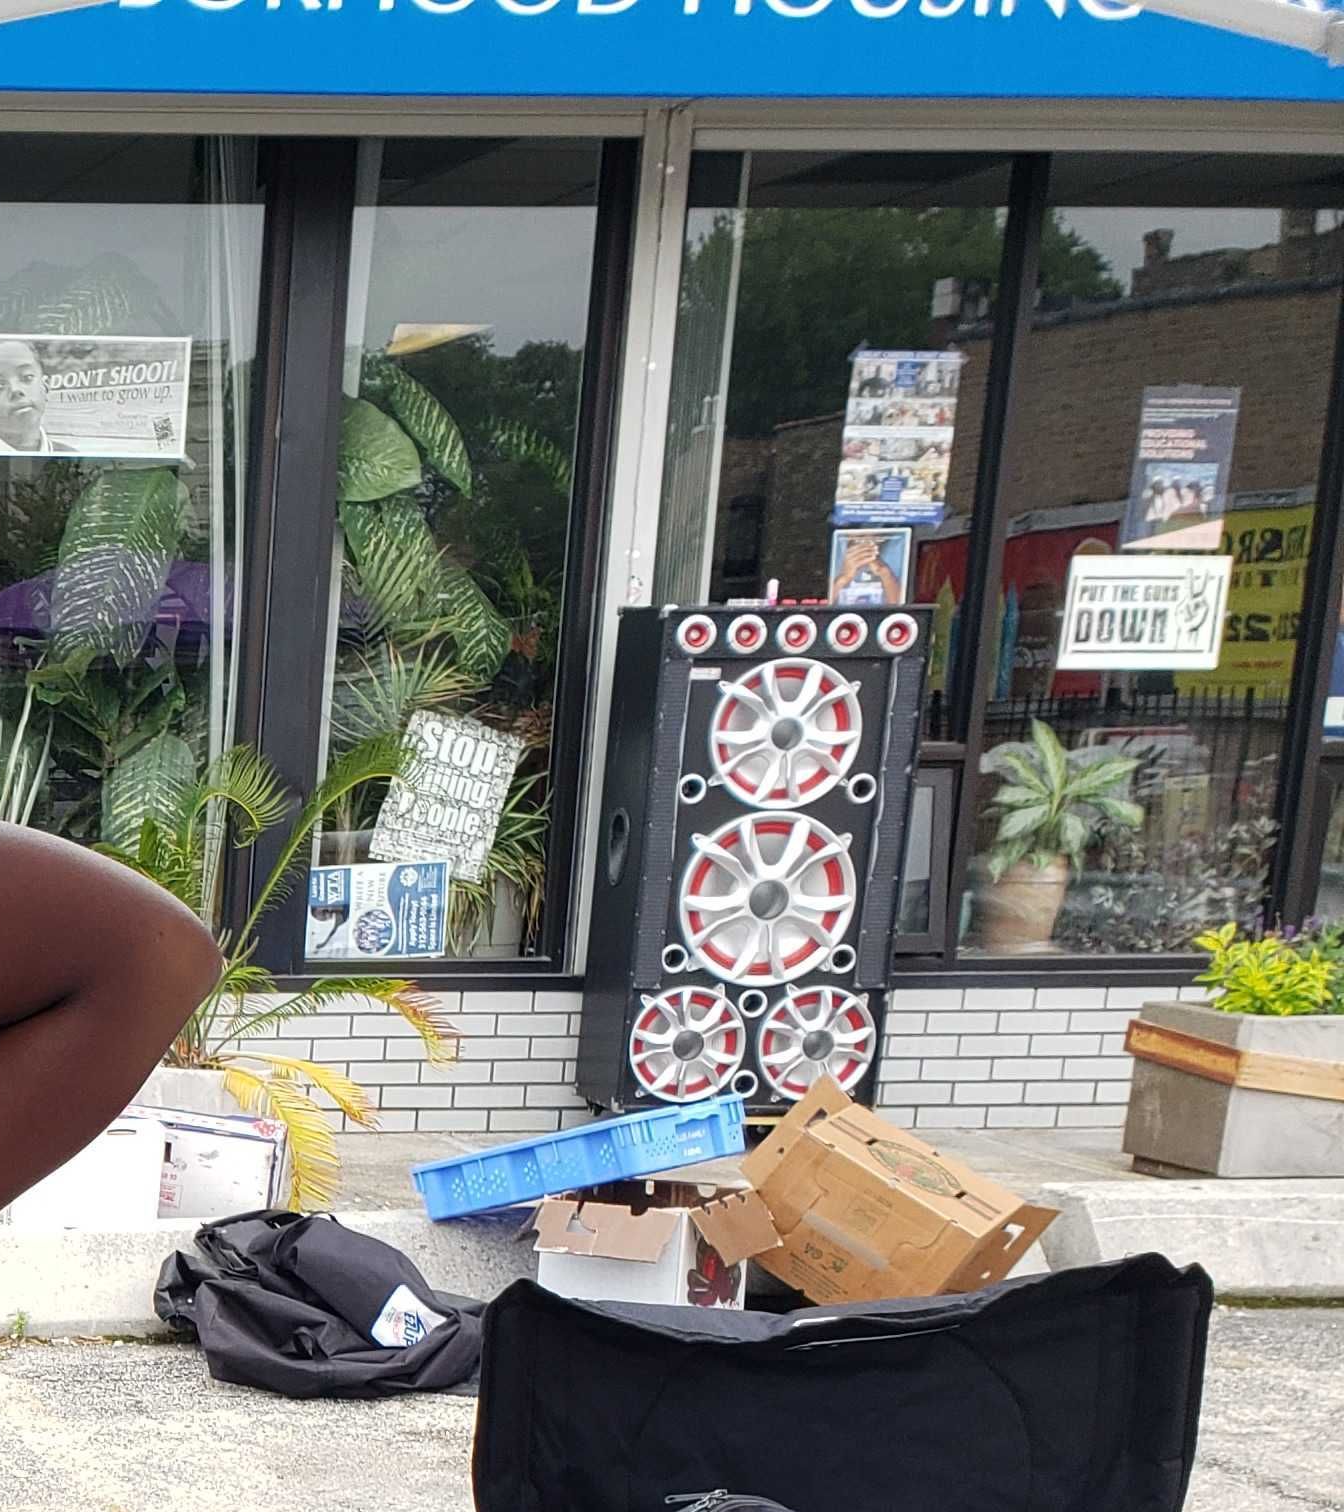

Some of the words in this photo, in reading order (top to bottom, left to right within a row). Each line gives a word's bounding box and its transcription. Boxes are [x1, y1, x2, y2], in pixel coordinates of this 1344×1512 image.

[51, 367, 108, 389] DON'T
[109, 360, 178, 385] SHOOT!
[116, 387, 150, 404] grow
[1080, 585, 1108, 602] PUT
[1112, 585, 1140, 602] THE
[1074, 608, 1169, 643] DOWN
[421, 720, 502, 776] Stop.
[327, 871, 340, 904] WTA
